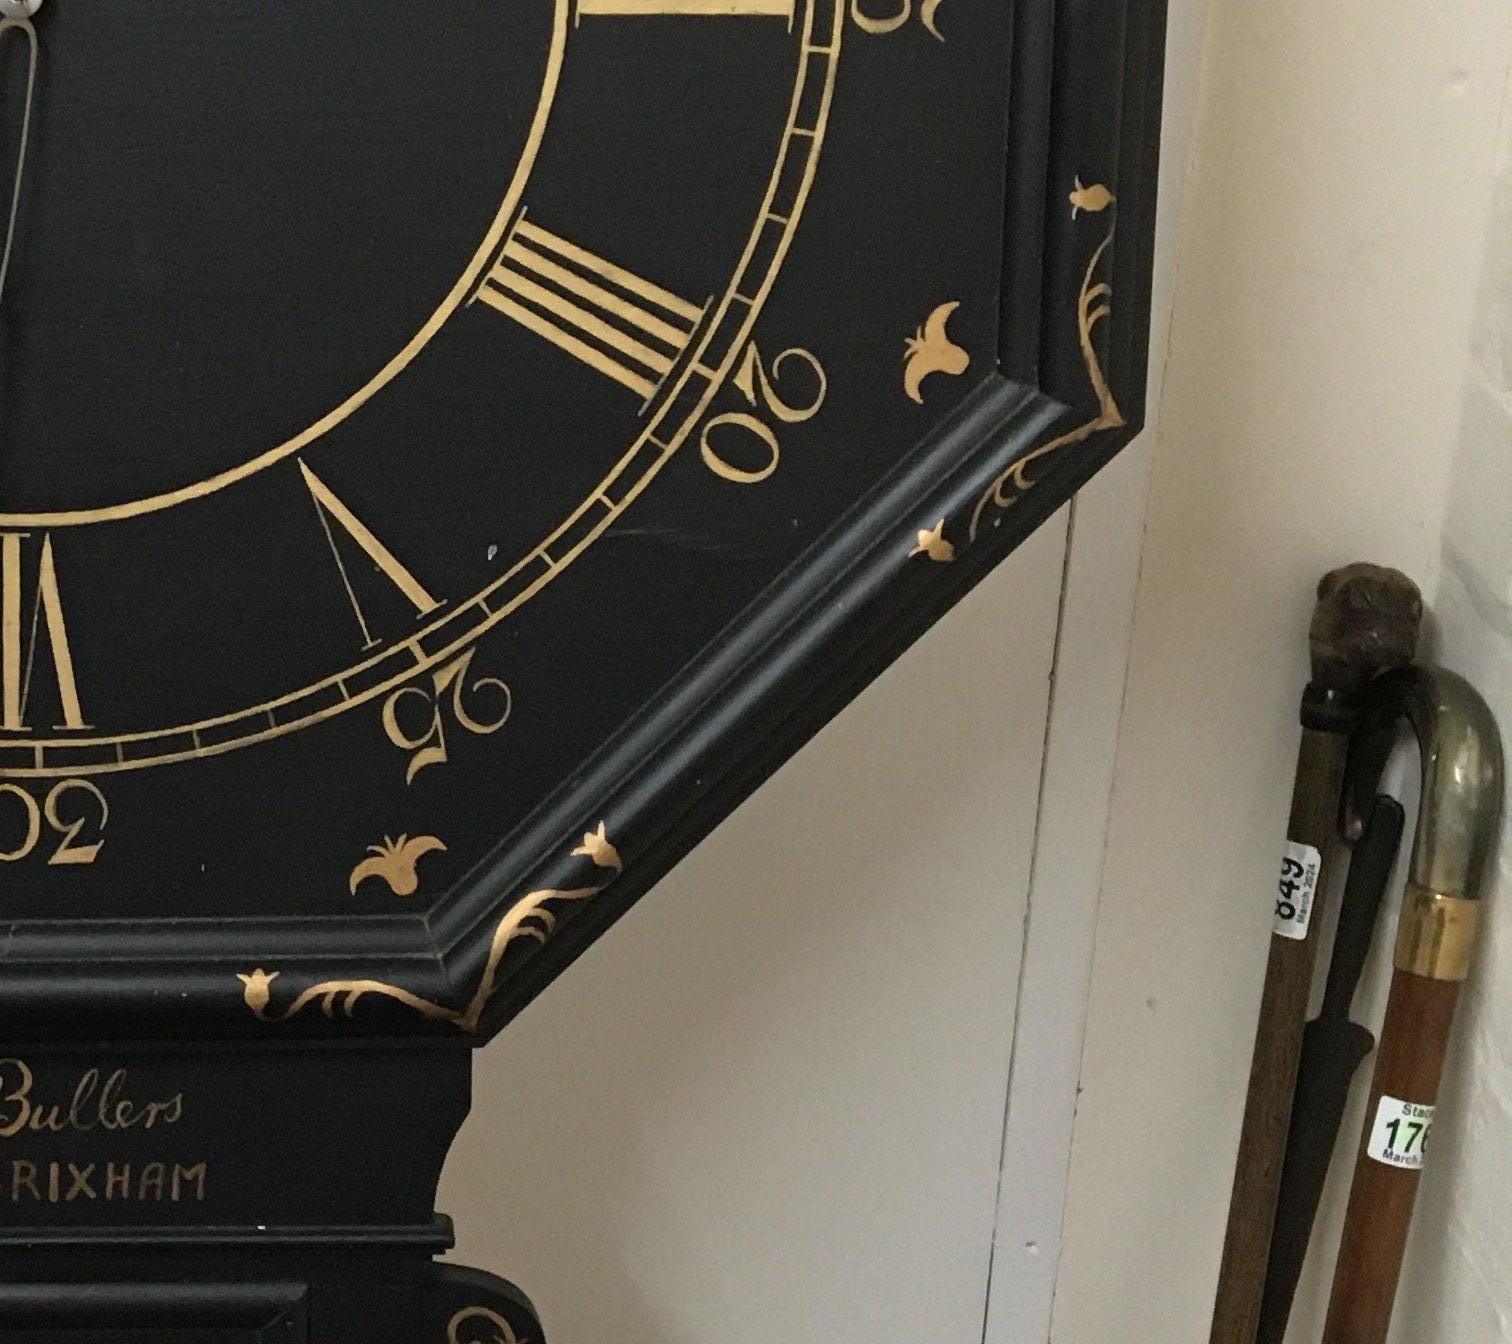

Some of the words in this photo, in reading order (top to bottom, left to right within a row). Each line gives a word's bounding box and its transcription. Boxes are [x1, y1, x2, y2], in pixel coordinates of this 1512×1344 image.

[466, 206, 713, 416] IIII
[700, 340, 826, 483] 20
[298, 457, 447, 650] V
[382, 647, 512, 785] 25
[1296, 891, 1310, 924] March
[1383, 1148, 1418, 1165] March
